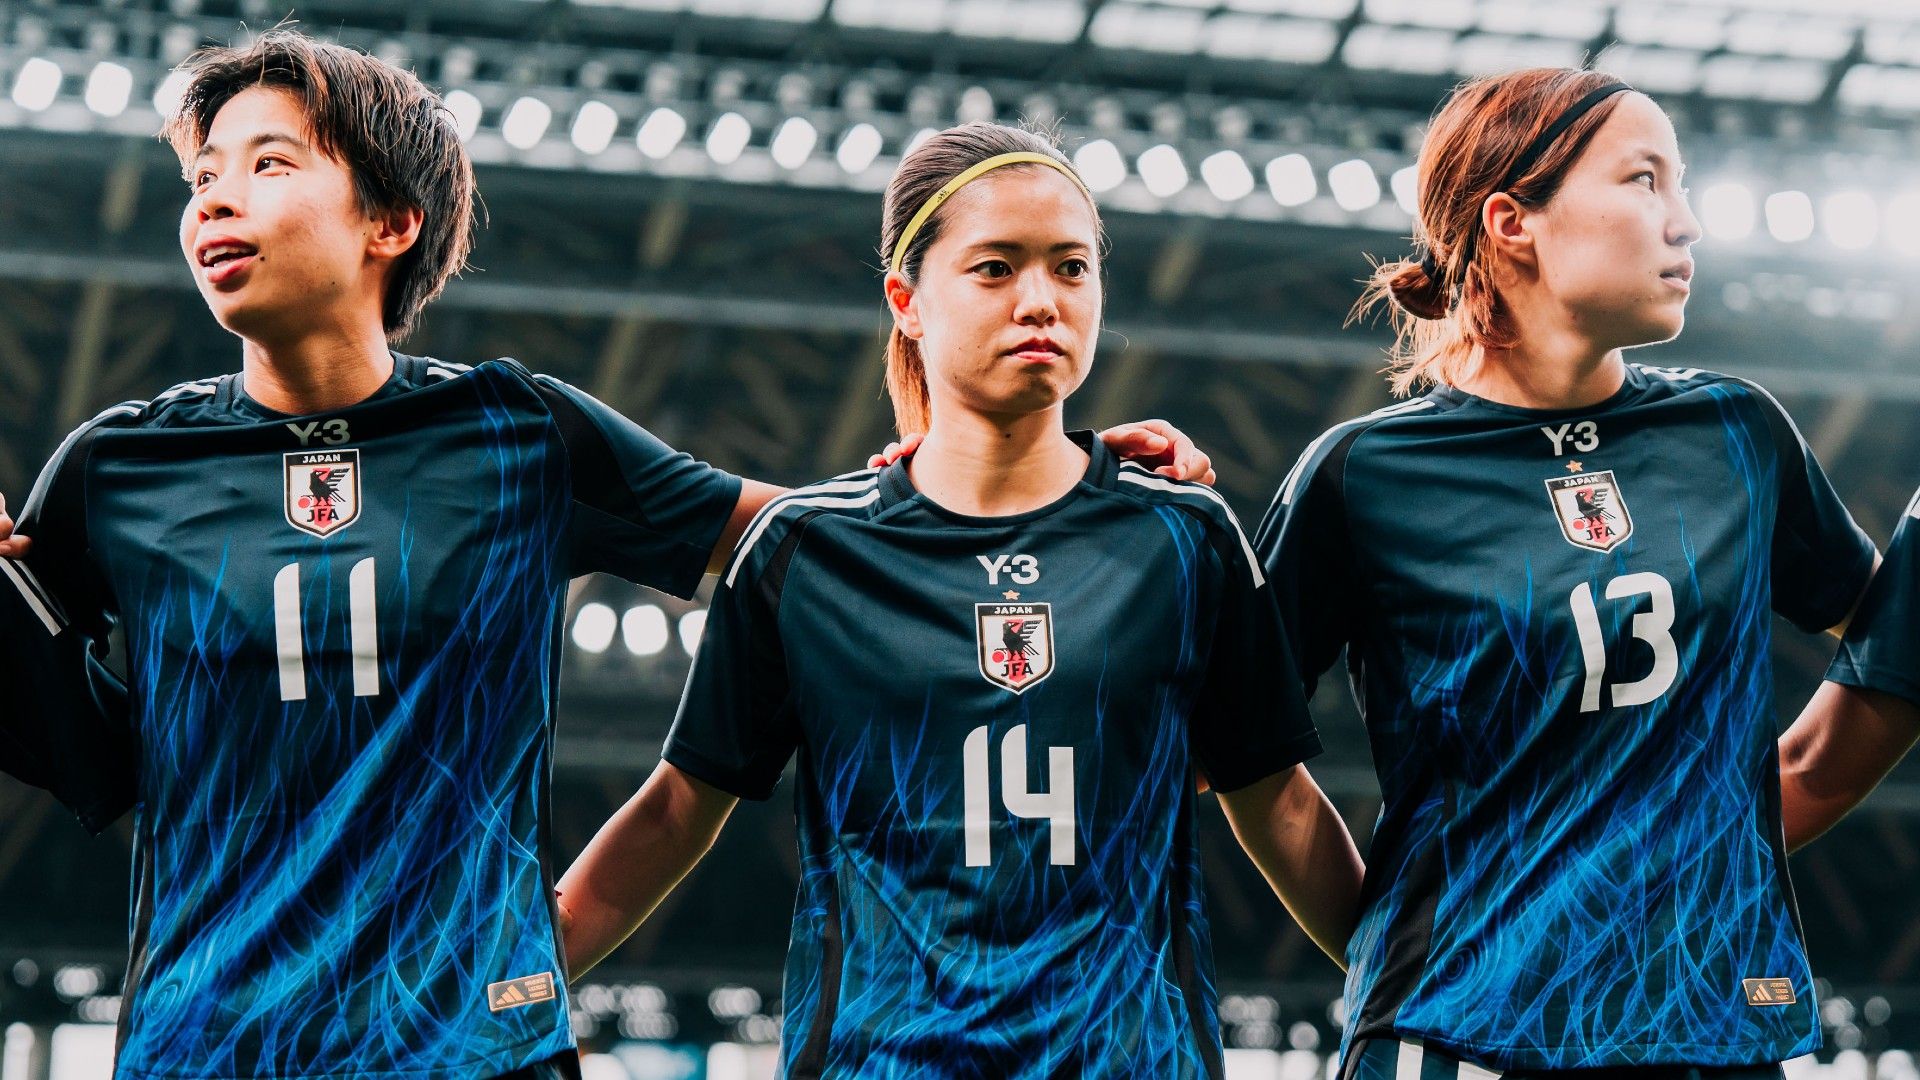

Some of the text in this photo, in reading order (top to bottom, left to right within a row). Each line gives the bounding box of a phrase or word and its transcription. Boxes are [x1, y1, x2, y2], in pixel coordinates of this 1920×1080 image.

[286, 418, 351, 446] Y-3
[1541, 421, 1600, 456] Y-3
[302, 453, 341, 464] JAPAN
[1563, 476, 1600, 487] JAPAN
[307, 508, 339, 522] JFA
[1586, 526, 1616, 541] JFA
[976, 554, 1040, 585] Y-3
[994, 606, 1033, 615] JAPAN
[273, 556, 380, 701] 11
[1569, 571, 1679, 713] 13
[1001, 662, 1034, 677] JFA
[963, 723, 1076, 867] 14
